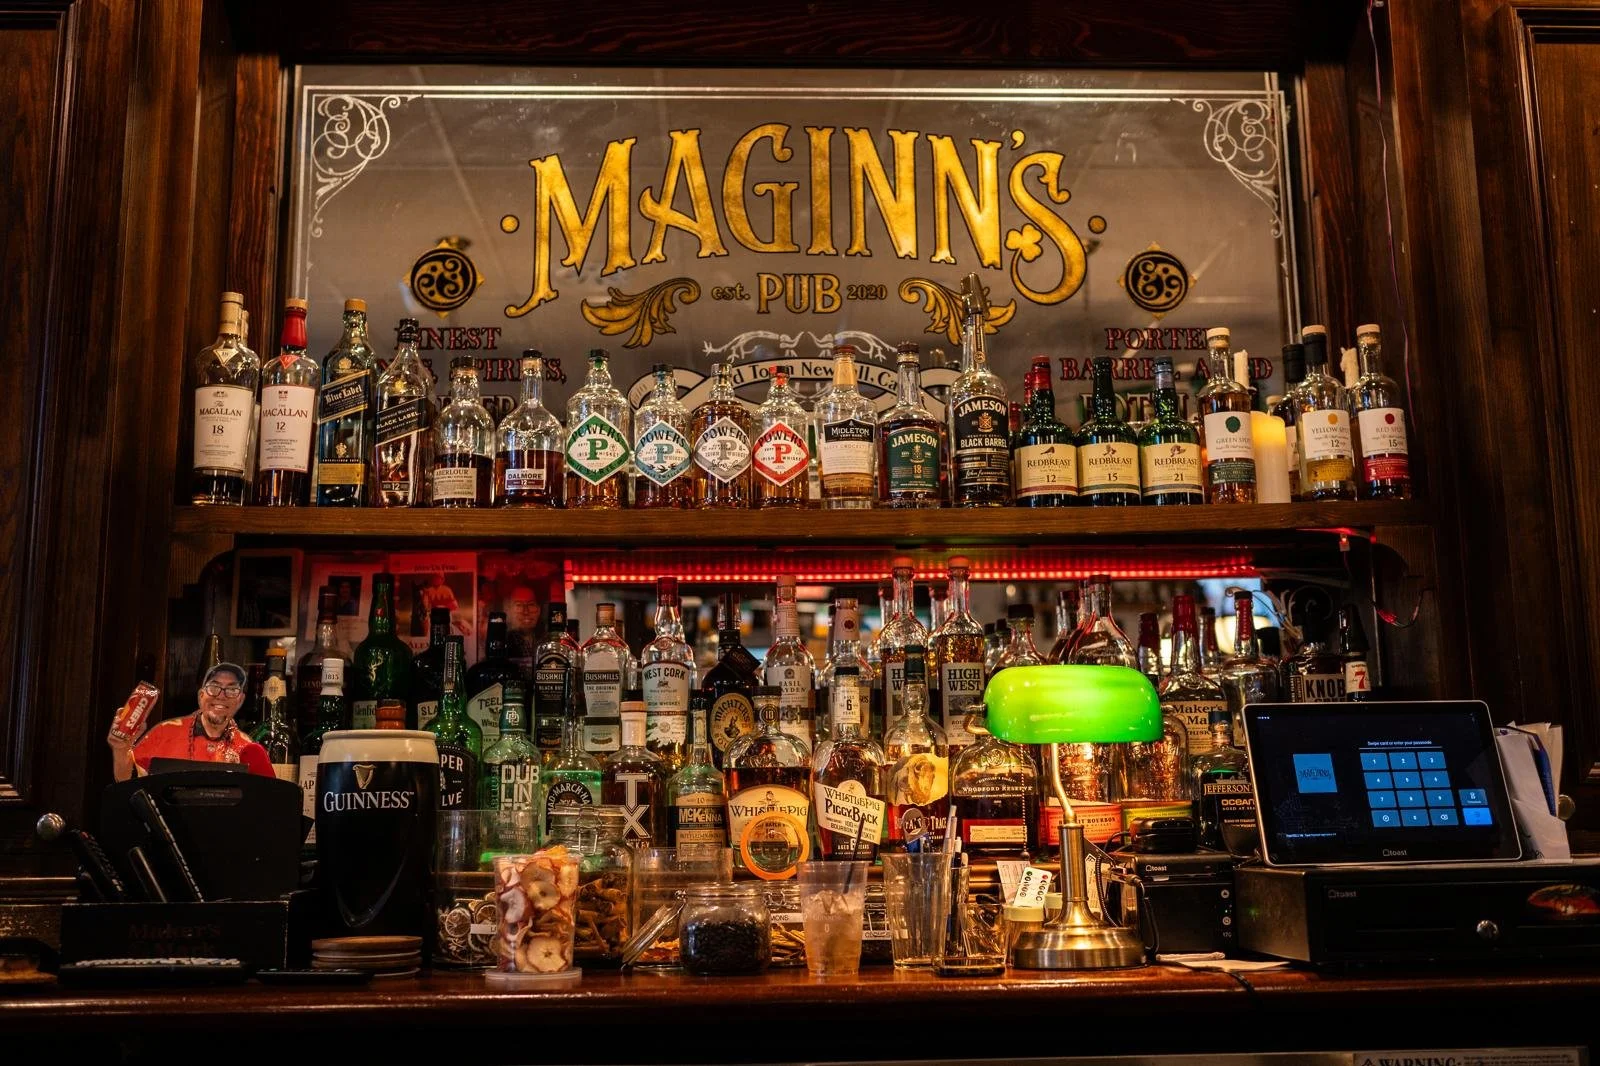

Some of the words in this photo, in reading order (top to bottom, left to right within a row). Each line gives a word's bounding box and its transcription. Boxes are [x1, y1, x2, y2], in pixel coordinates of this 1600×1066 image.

[504, 122, 1088, 318] MAGINN'S
[711, 284, 750, 301] est.
[756, 272, 843, 314] PUB
[846, 283, 889, 301] 2020
[393, 327, 502, 350] INEST
[748, 364, 794, 379] Ton
[801, 361, 874, 382] Newll,
[1060, 358, 1181, 380] BARRE,
[324, 392, 343, 408] Blue
[342, 384, 363, 402] Label
[199, 408, 243, 418] MACALLAN
[262, 408, 309, 419] MACALLAN
[958, 400, 1007, 418] JAMESON
[211, 425, 225, 435] 18
[276, 422, 287, 432] 12
[571, 423, 623, 443] POWERS
[831, 428, 870, 436] MIDLETON
[640, 429, 685, 448] POWERS
[702, 426, 747, 444] POWERS
[758, 431, 803, 448] POWERS
[892, 433, 938, 448] JAMESON
[960, 438, 983, 449] BLACK
[984, 436, 1008, 449] BARREL
[1331, 439, 1340, 447] 12
[1389, 439, 1398, 447] 15
[586, 438, 609, 461] P
[654, 443, 674, 464] P
[716, 439, 738, 461] P
[772, 444, 793, 464] P
[1027, 459, 1072, 469] REDBREAST
[1088, 457, 1132, 466] REDBREAST
[1154, 457, 1198, 466] REDBREAST
[914, 464, 923, 474] 18
[1046, 474, 1057, 483] 12
[1106, 472, 1118, 481] 15
[1173, 473, 1184, 482] 21
[392, 482, 401, 491] 12
[537, 672, 564, 681] BUSHMIL
[585, 672, 619, 681] BUSHMILLS
[644, 669, 662, 680] WEST
[664, 668, 686, 680] CORK
[892, 669, 905, 679] HI
[948, 669, 981, 680] HIGH
[1355, 671, 1366, 689] 7
[949, 680, 981, 691] WEST
[1306, 679, 1345, 698] KNOB
[421, 706, 438, 716] SLA
[478, 699, 502, 712] TEEL
[847, 700, 853, 711] 6
[1174, 704, 1223, 714] Maker's
[1187, 716, 1207, 724] Ma
[440, 755, 464, 773] PER
[501, 765, 540, 784] DUB
[303, 781, 315, 790] AP
[962, 785, 1000, 793] WOODFORD
[1001, 785, 1034, 793] RESERVE
[1203, 783, 1253, 795] JEFFERSON'
[441, 791, 463, 807] LVE
[501, 784, 532, 803] LIN
[553, 783, 582, 796] MARCH
[581, 792, 591, 805] HA
[824, 787, 881, 811] WHISTLEPIG
[324, 792, 409, 812] GUINNESS
[615, 773, 651, 839] TX
